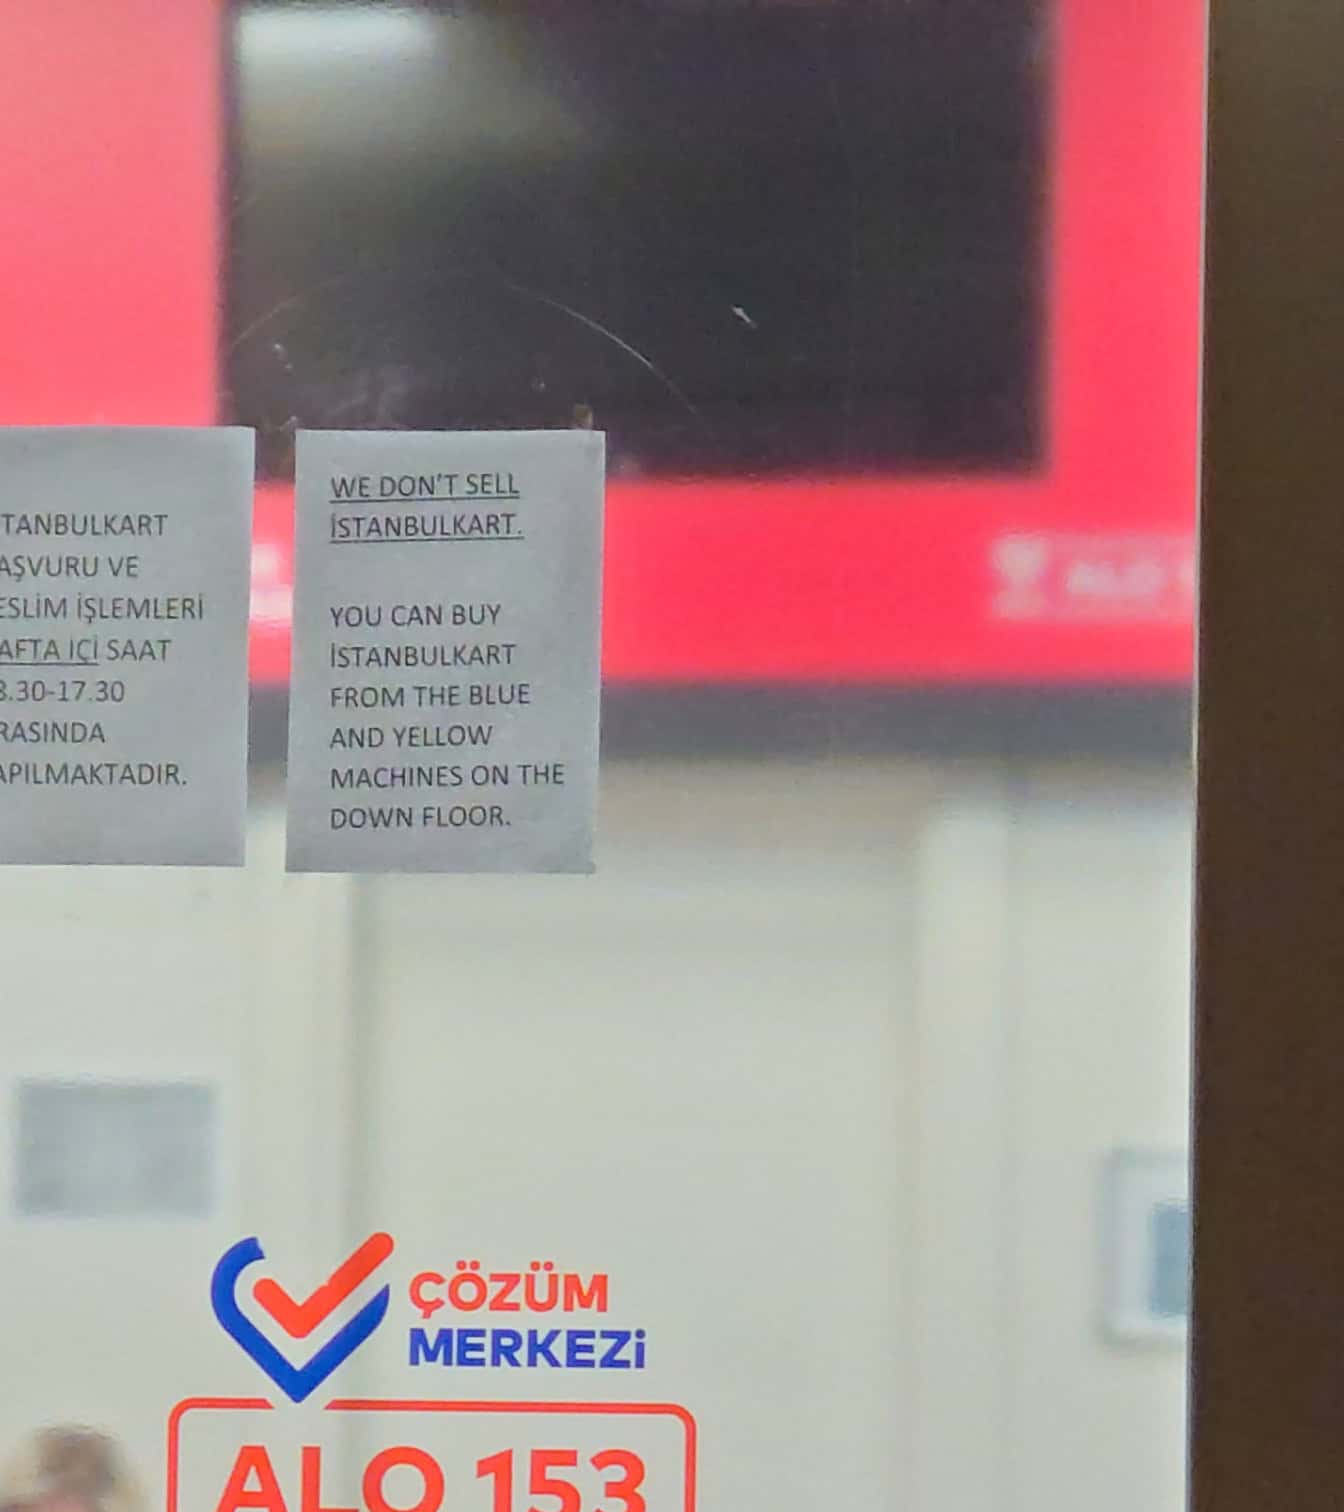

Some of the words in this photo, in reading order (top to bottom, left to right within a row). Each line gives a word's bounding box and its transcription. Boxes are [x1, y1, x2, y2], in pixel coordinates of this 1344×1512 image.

[330, 475, 370, 499] WE
[379, 473, 456, 497] DON'T
[464, 472, 520, 495] SELL
[330, 511, 523, 540] İSTANBULKART.
[109, 556, 139, 578] VE
[77, 592, 205, 626] İŞLEMLERİ
[330, 604, 386, 629] YOU
[391, 604, 444, 627] CAN
[451, 603, 502, 627] BUY
[107, 637, 172, 662] SAAT
[330, 641, 517, 669] İSTANBULKART
[331, 685, 405, 709] FROM
[414, 684, 461, 708] THE
[469, 683, 531, 707] BLUE
[330, 726, 385, 750] AND
[393, 724, 494, 749] YELLOW
[330, 765, 463, 791] MACHINES
[472, 765, 511, 789] ON
[518, 764, 565, 788] THE
[330, 805, 415, 831] DOWN
[423, 804, 511, 829] FLOOR.
[408, 1260, 609, 1319] ÇÖZÜM
